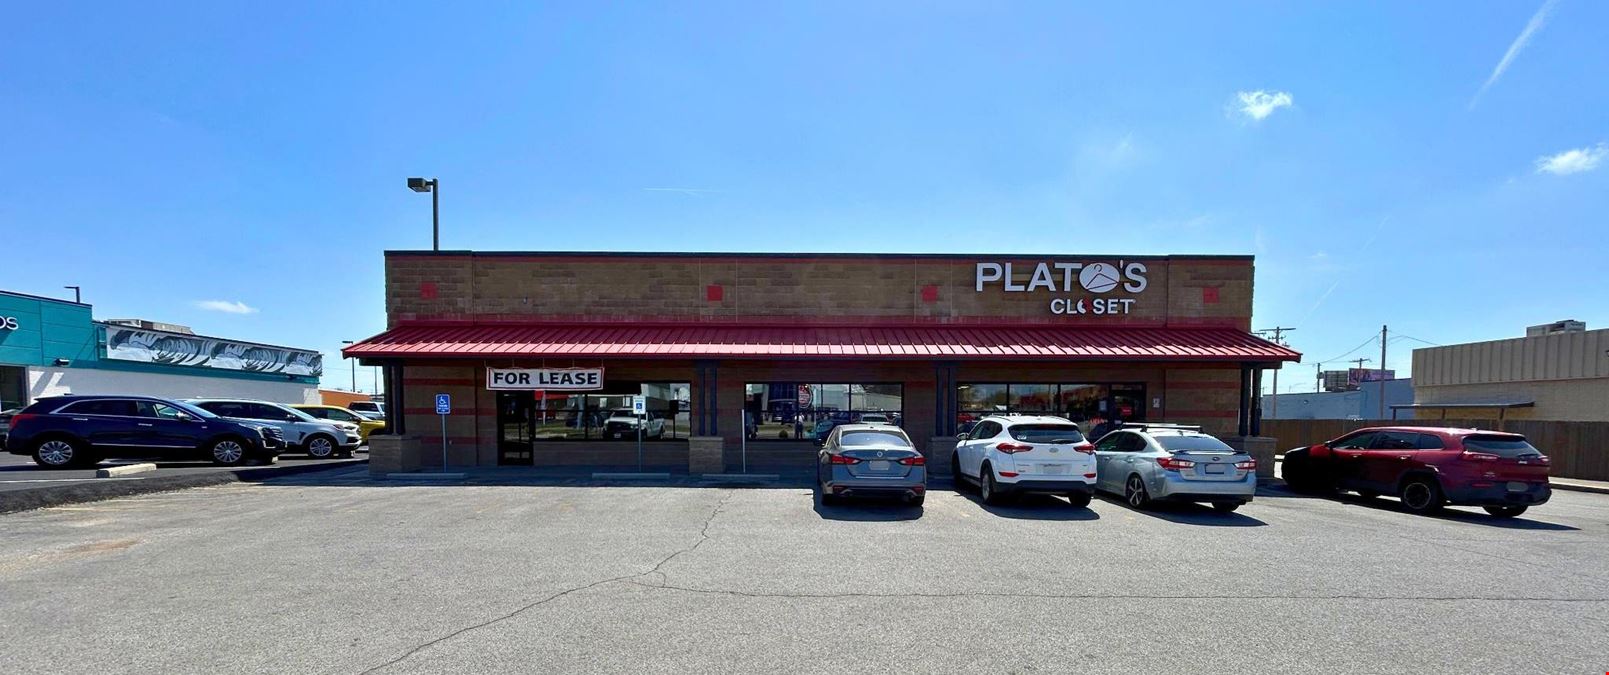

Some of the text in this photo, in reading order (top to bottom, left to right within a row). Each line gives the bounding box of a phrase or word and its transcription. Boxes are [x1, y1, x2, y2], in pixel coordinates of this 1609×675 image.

[976, 260, 1147, 293] PLATO'S
[1050, 298, 1134, 315] CLOSET
[494, 372, 598, 385] FOR LEASE
